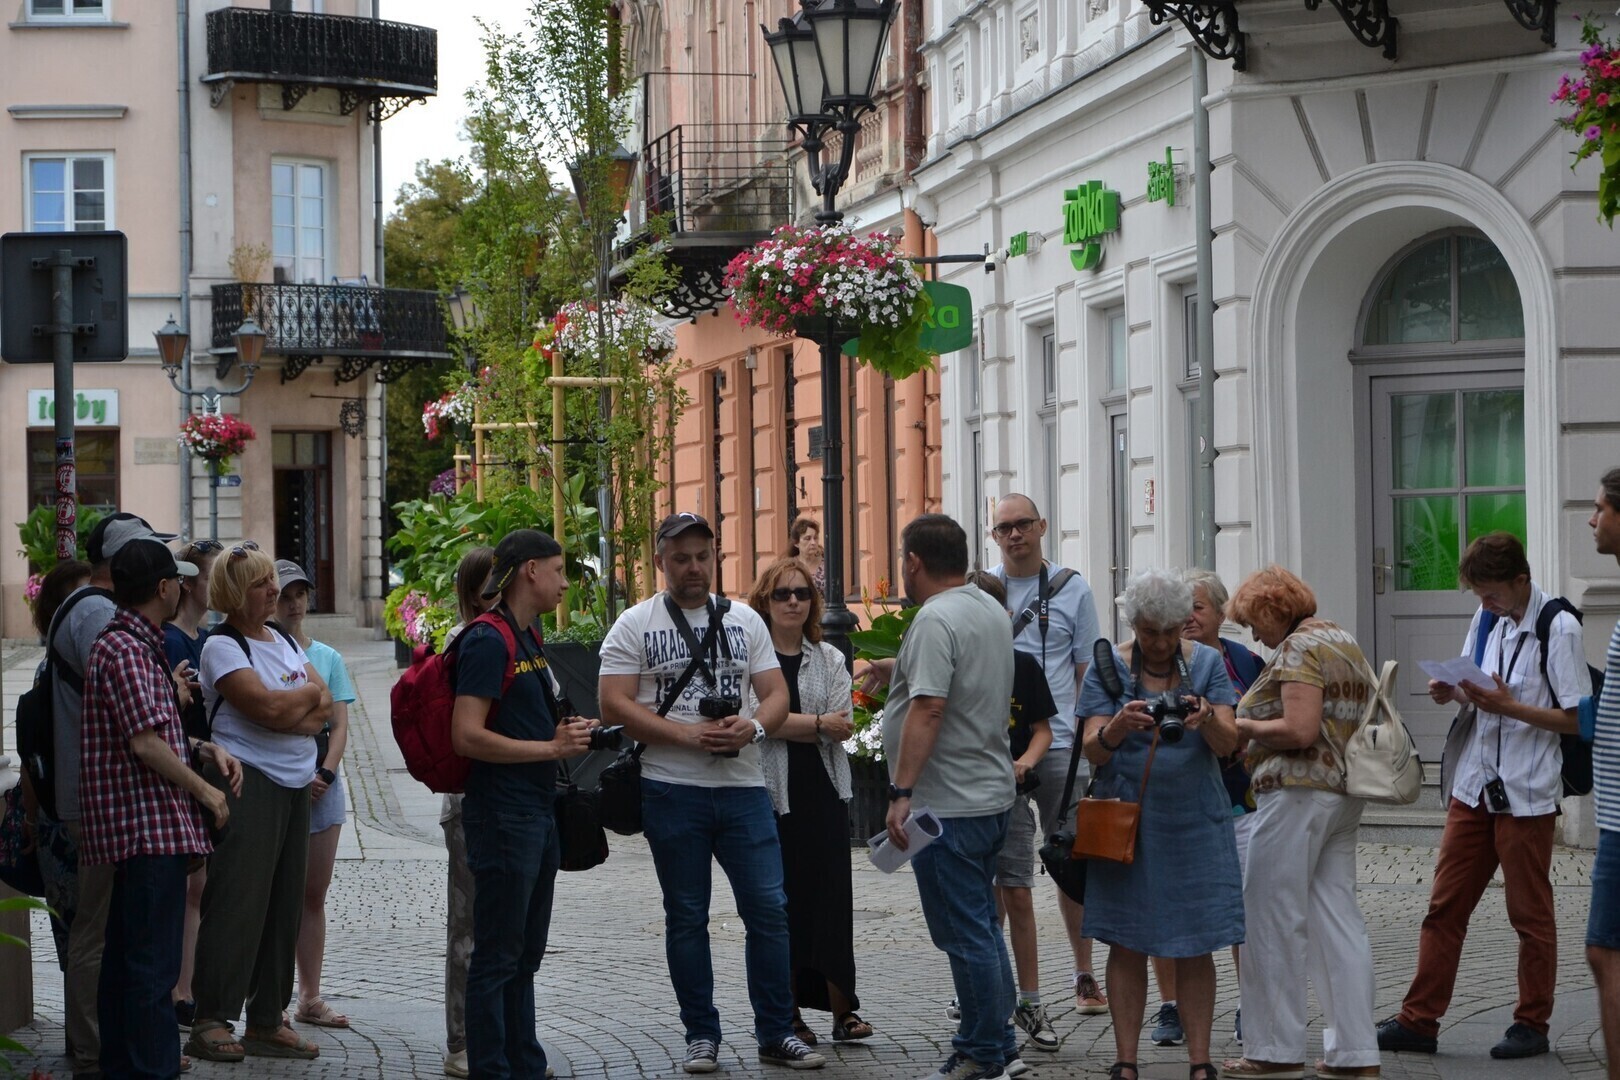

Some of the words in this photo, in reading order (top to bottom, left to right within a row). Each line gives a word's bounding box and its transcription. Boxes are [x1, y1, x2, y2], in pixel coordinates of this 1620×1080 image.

[38, 392, 106, 424] tby
[720, 675, 742, 698] 85
[656, 704, 692, 712] OGINAL
